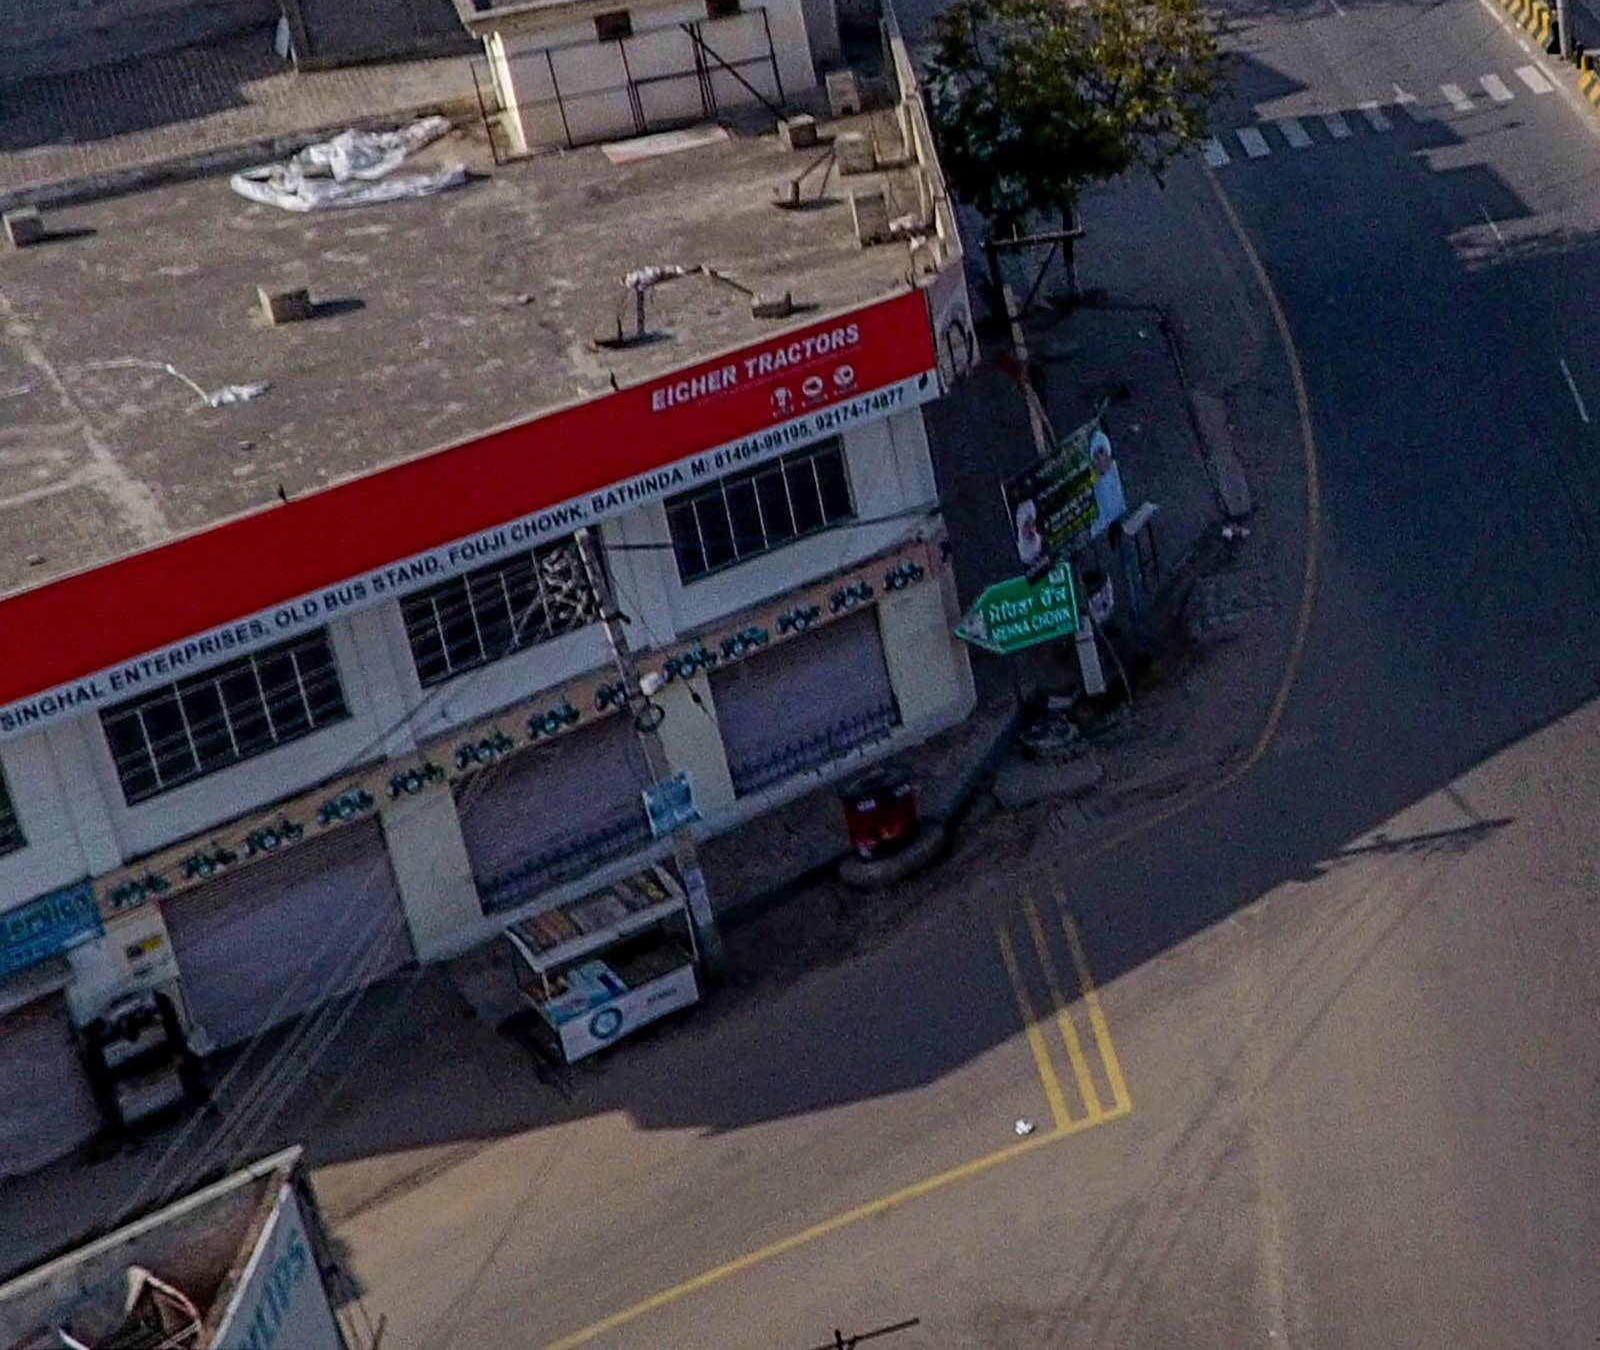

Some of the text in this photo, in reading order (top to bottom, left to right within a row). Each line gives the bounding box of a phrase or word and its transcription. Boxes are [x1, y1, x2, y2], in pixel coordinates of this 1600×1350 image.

[652, 323, 860, 412] EICHER TRACTORS
[0, 683, 104, 733] SINGHAL
[109, 621, 270, 697] ENTERPRISES,
[275, 595, 320, 630] OLD
[323, 581, 367, 614] BUS
[371, 558, 446, 601] STAND,
[449, 530, 508, 567] FOUJI
[511, 504, 588, 546] CHOWK,
[591, 471, 684, 520] BATHINDA
